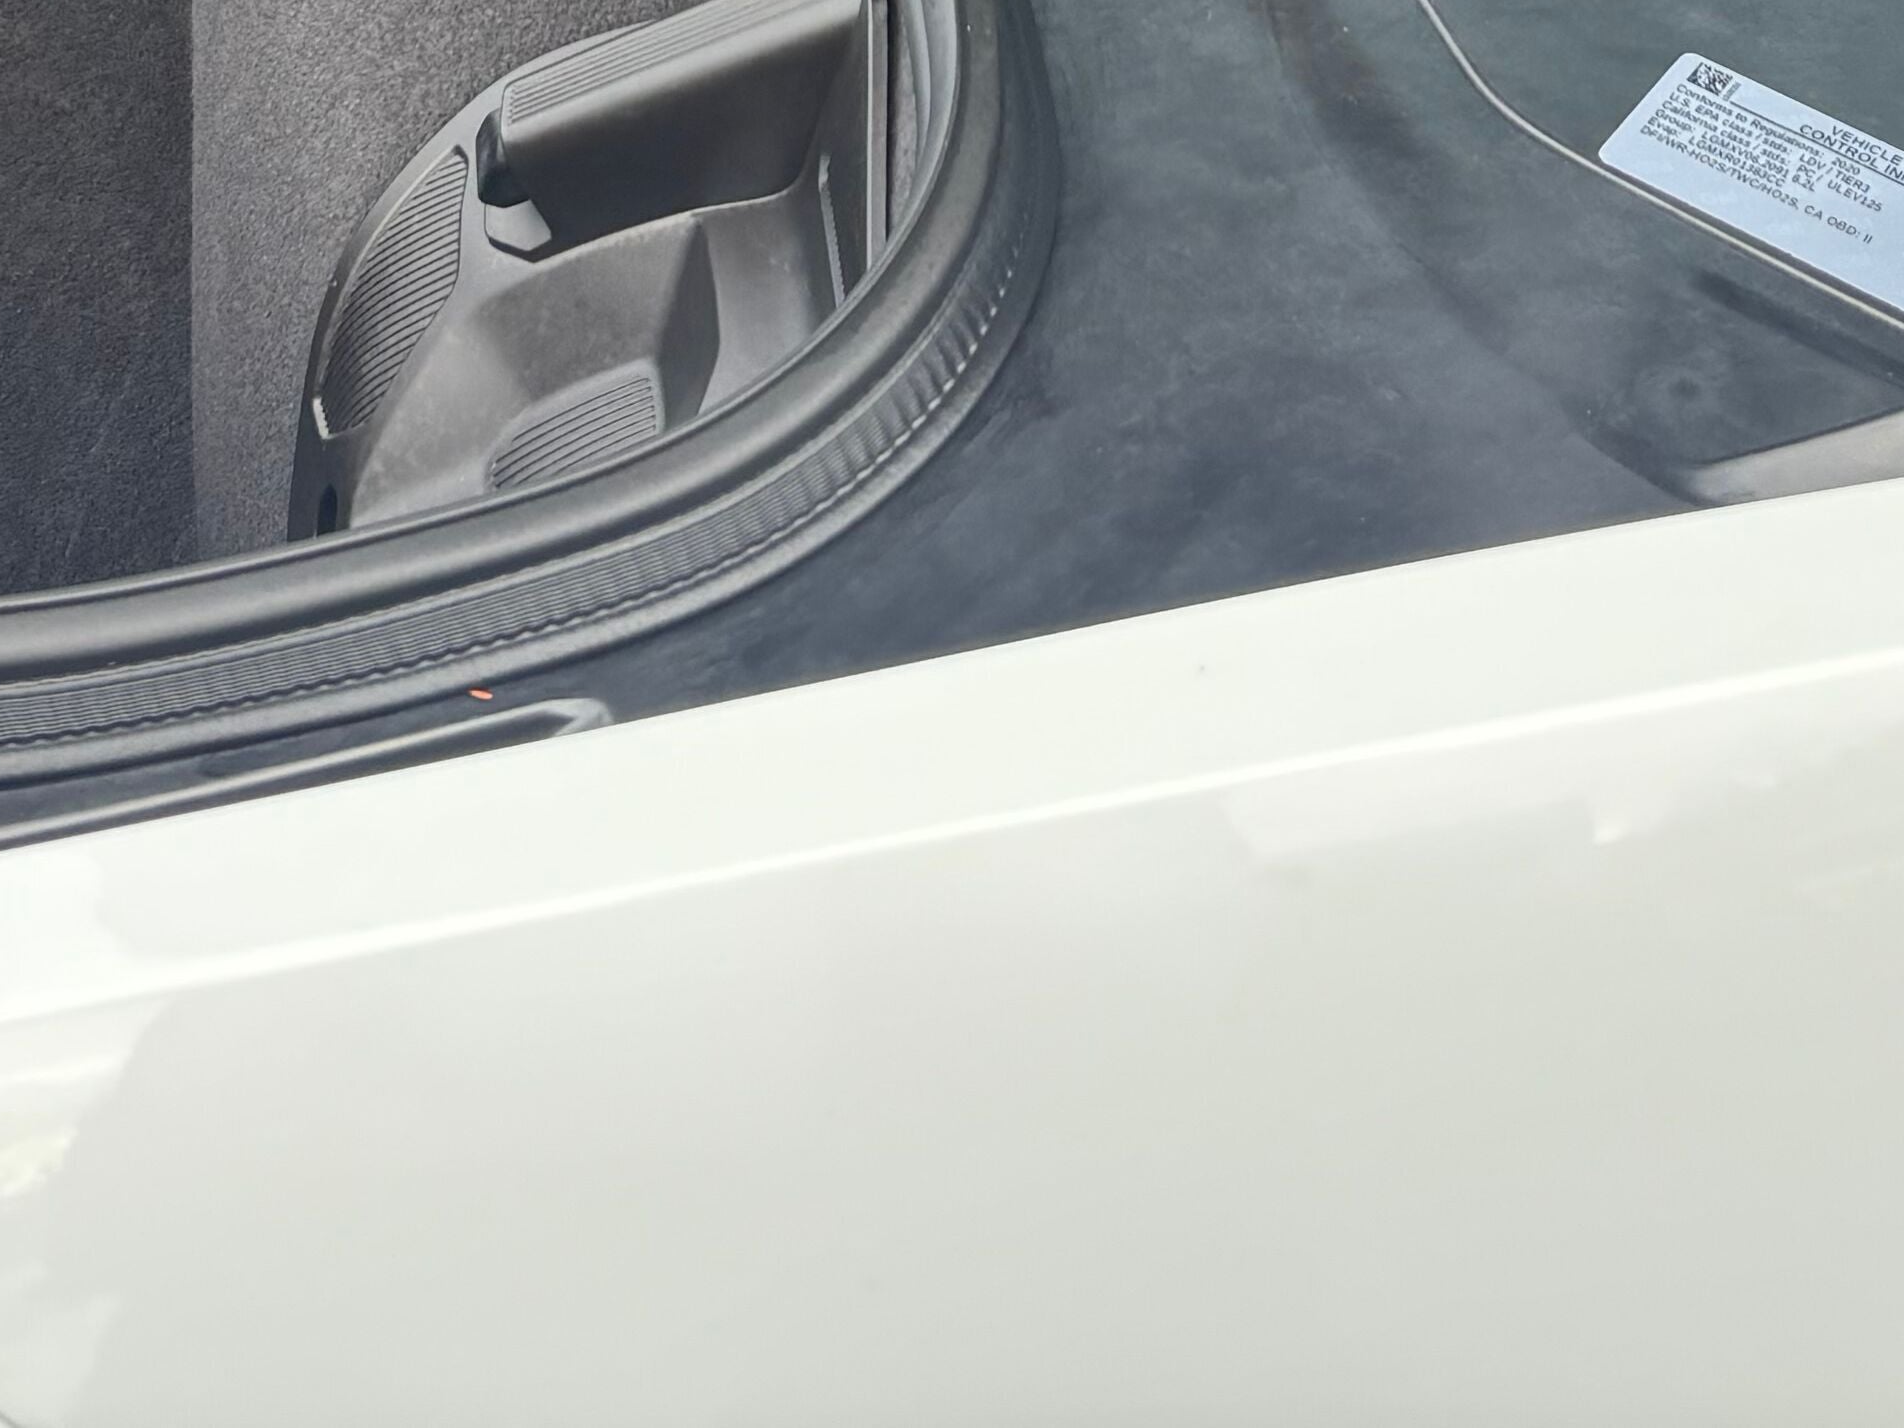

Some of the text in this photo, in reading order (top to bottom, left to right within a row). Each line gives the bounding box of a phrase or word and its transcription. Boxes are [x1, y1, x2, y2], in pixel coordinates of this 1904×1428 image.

[1645, 115, 1683, 139] Evap:
[1652, 108, 1697, 134] Group:
[1673, 83, 1735, 117] Conforms
[1733, 111, 1749, 123] to
[1747, 118, 1825, 161] Regulations:
[1830, 156, 1862, 176] 2020
[1660, 99, 1720, 133] California
[1718, 127, 1753, 148] class
[1795, 164, 1817, 179] PC
[1824, 179, 1884, 212] ULEV125
[1693, 104, 1722, 122] EPA
[1720, 116, 1755, 138] class
[1797, 153, 1826, 171] LDV
[1832, 169, 1871, 193] TIER3
[1797, 122, 1883, 169] CONTROL
[1828, 125, 1903, 166] VEHICLE
[1802, 204, 1826, 220] CA
[1824, 215, 1862, 238] OBD:
